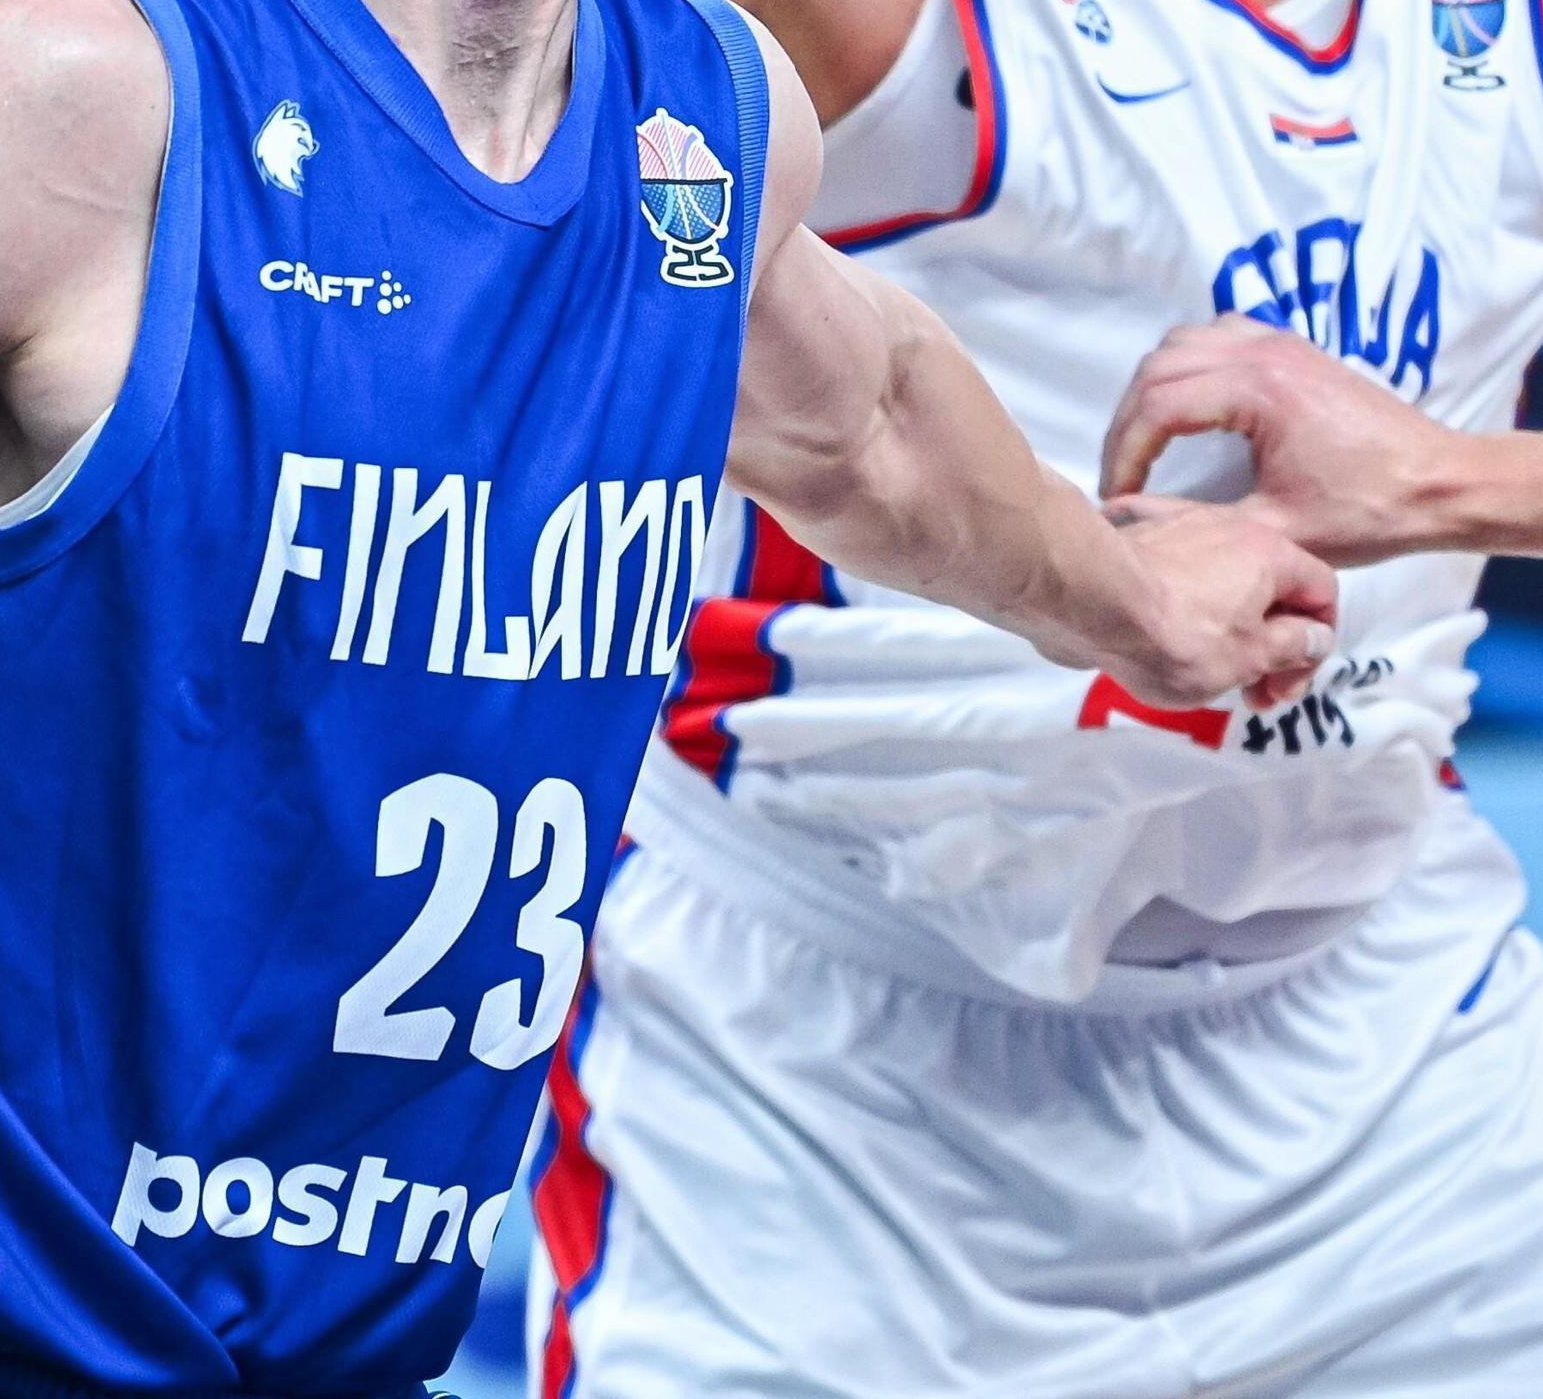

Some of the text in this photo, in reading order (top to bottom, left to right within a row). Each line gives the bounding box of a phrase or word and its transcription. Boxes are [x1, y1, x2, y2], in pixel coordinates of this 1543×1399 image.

[259, 259, 375, 307] CRAFT
[241, 452, 706, 680] FINLAND
[333, 772, 587, 1070] 23
